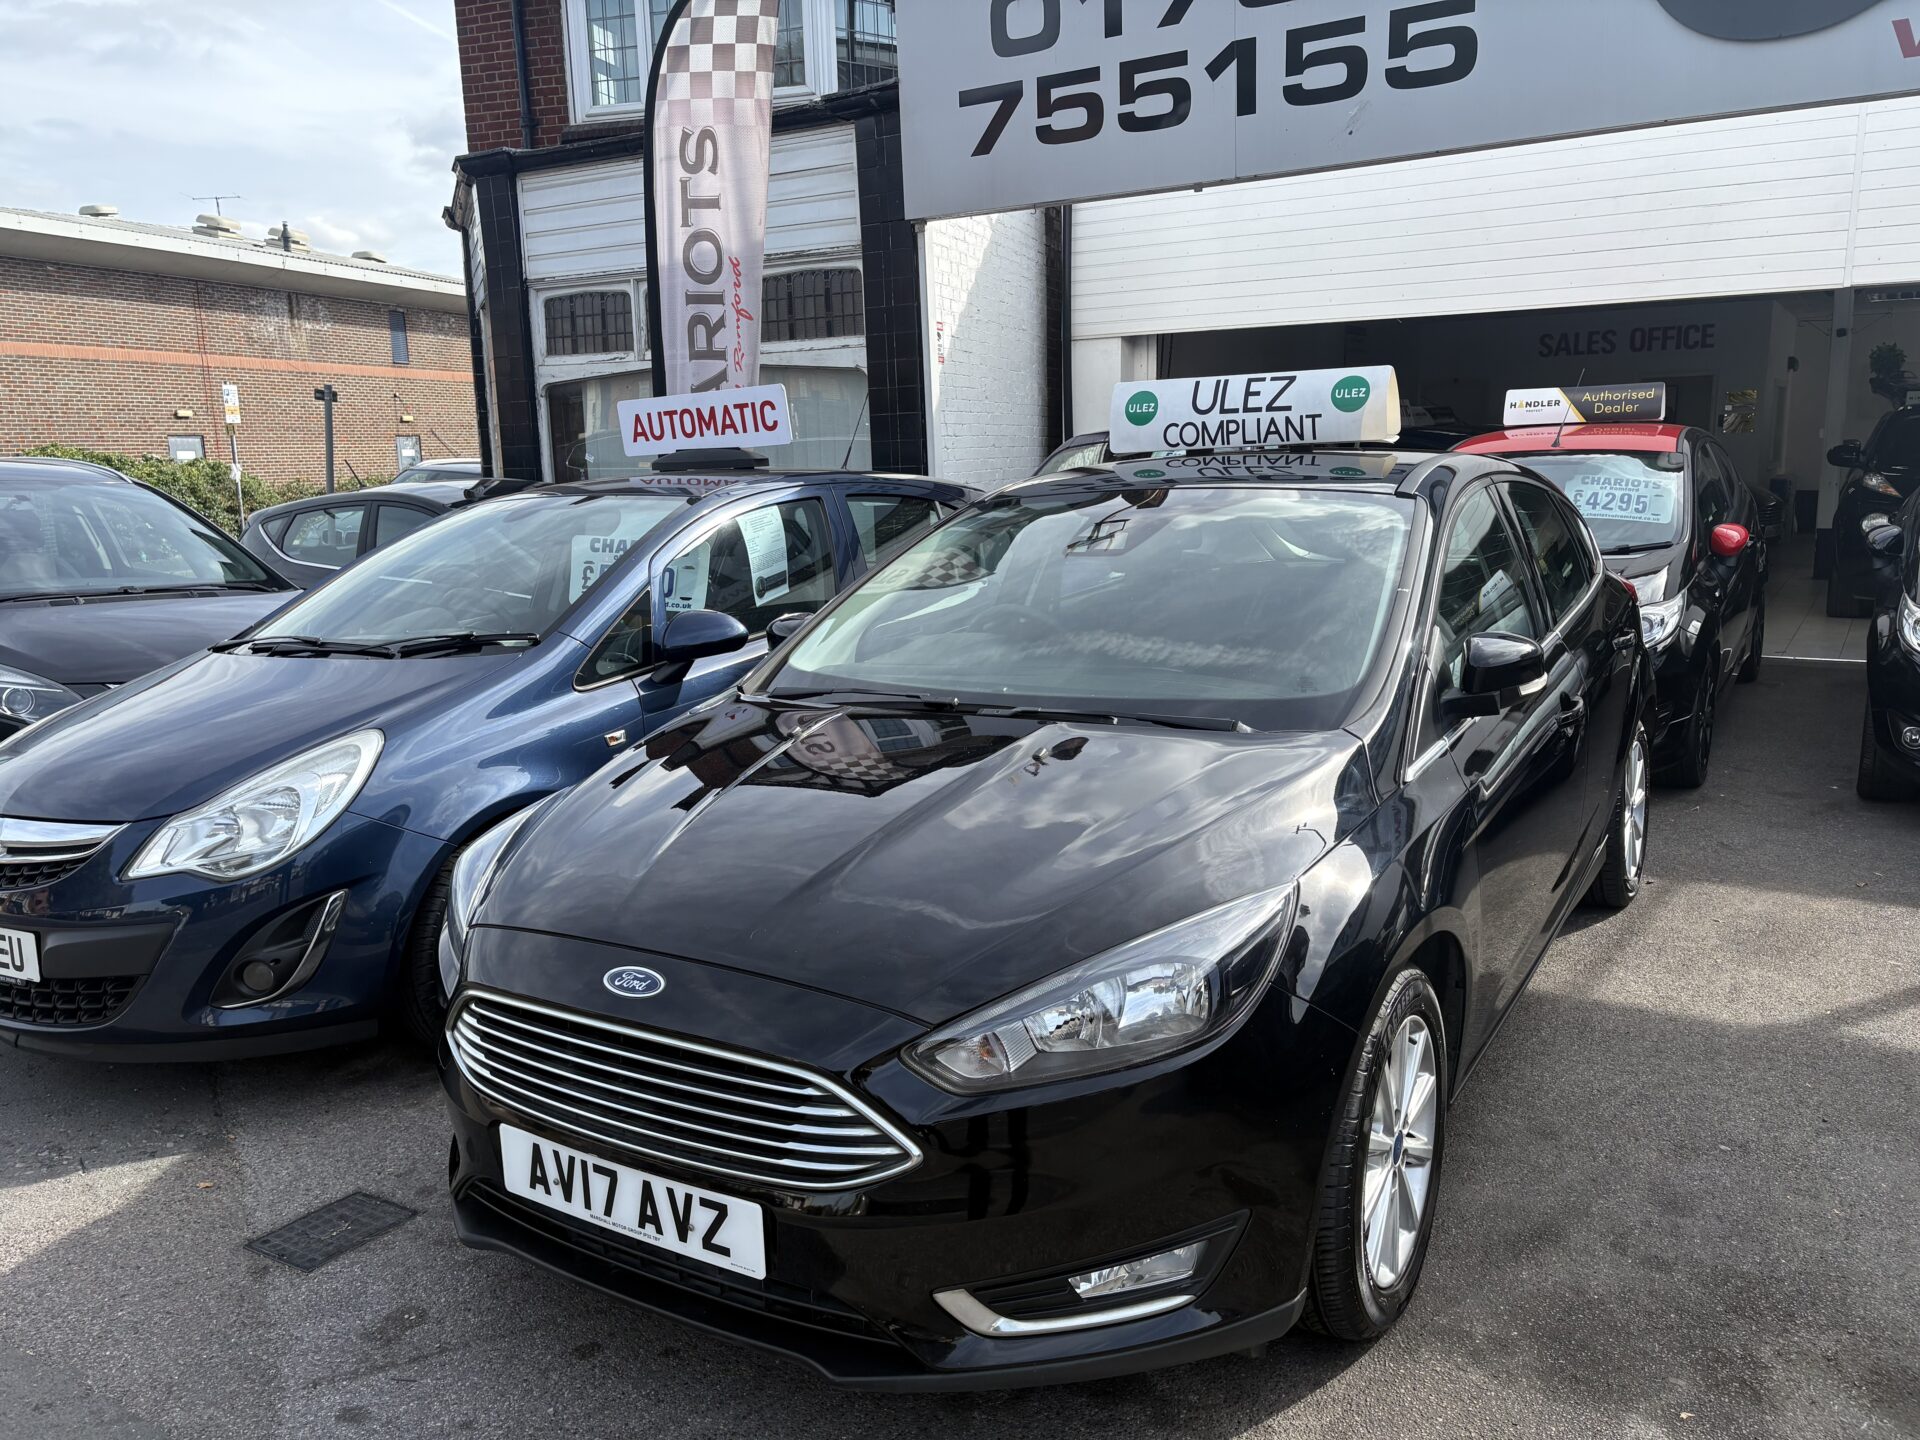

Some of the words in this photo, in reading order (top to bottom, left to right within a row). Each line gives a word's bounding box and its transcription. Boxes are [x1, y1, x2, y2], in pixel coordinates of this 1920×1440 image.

[958, 0, 1479, 158] 755155
[728, 255, 754, 373] Romford
[1538, 329, 1617, 358] SALES
[1629, 323, 1716, 352] OFFICE
[1191, 375, 1298, 416] ULEZ
[1335, 387, 1366, 399] ULEZ
[1581, 388, 1655, 402] Authorised
[1128, 402, 1155, 413] ULEZ
[1594, 402, 1640, 414] Dealer
[632, 399, 779, 443] AUTOMATIC
[1163, 413, 1323, 448] COMPLIANT
[1580, 475, 1662, 490] CHARIOTS
[1573, 491, 1648, 514] £4295
[614, 971, 652, 991] Ford
[529, 1142, 618, 1218] AV17
[637, 1179, 731, 1258] AVZ
[612, 1221, 627, 1230] MOTOR
